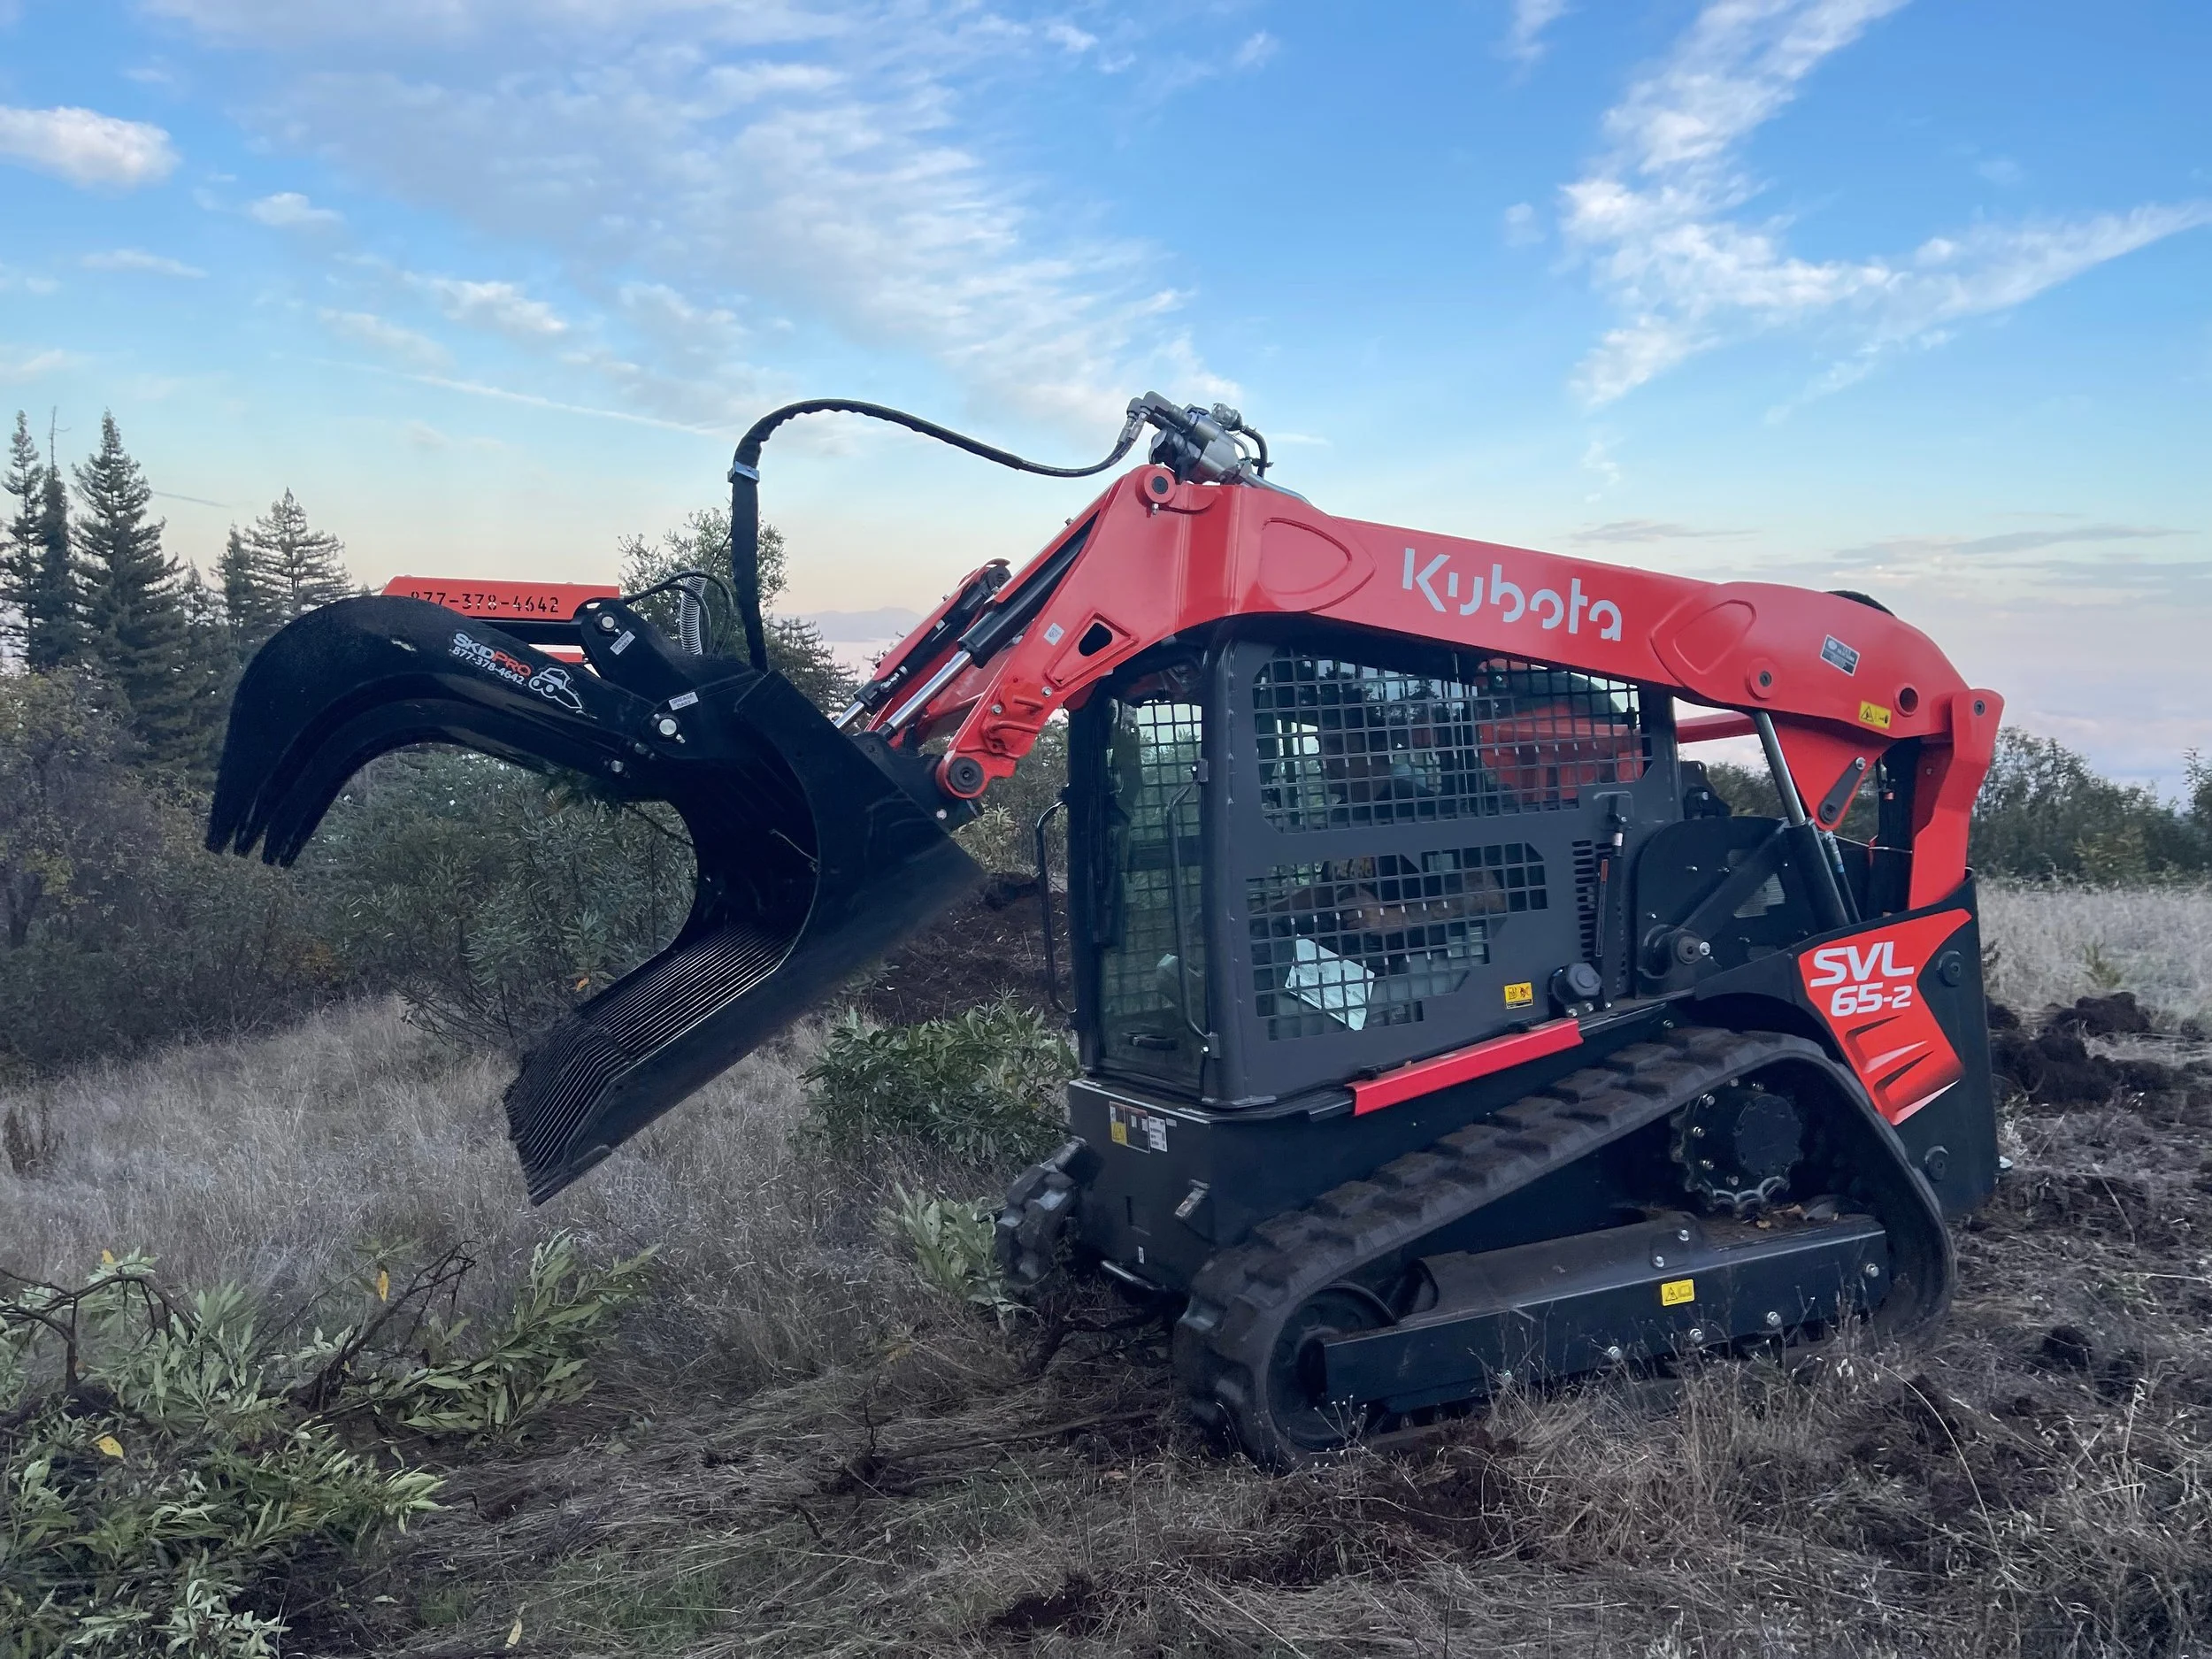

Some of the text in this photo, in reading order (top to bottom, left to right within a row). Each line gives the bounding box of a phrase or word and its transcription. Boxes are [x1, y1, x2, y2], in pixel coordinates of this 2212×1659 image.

[1402, 548, 1622, 641] Kubota
[452, 647, 525, 685] 877-378-4642
[453, 633, 531, 676] SKIDPRO
[1810, 941, 1914, 987] SVL
[1831, 982, 1912, 1017] 65-2
